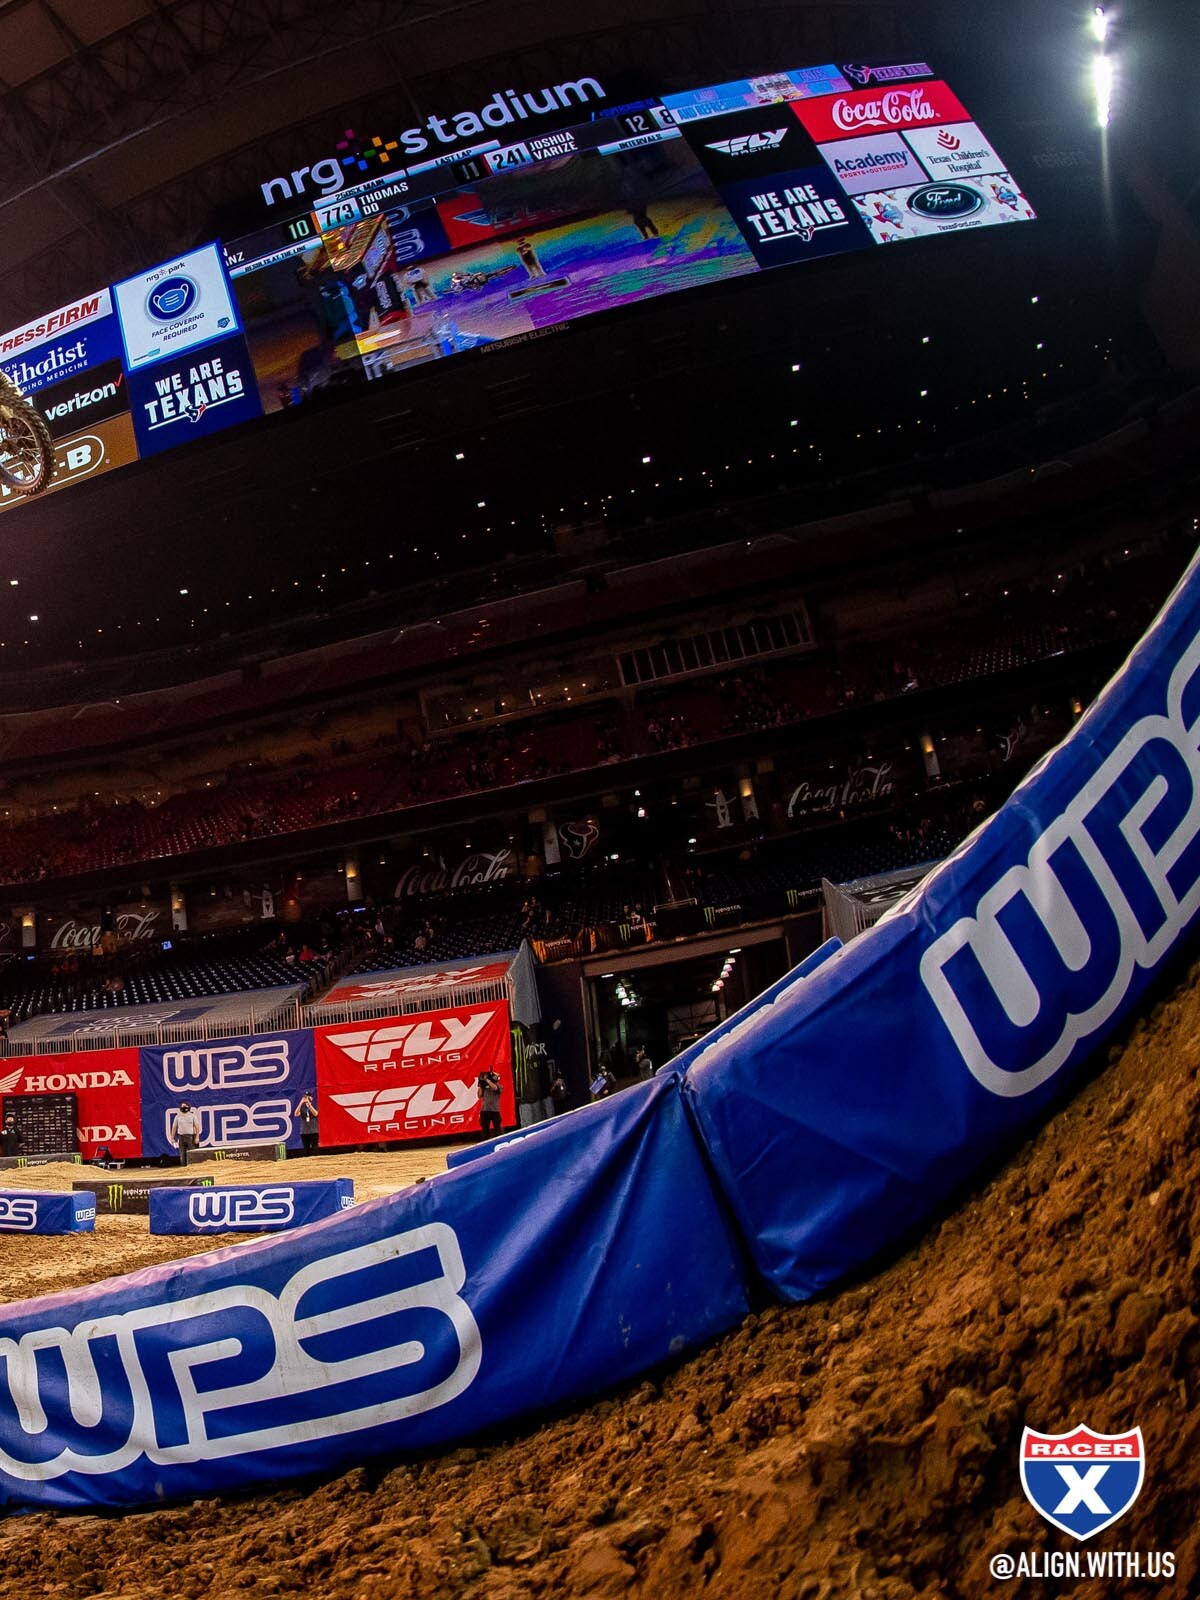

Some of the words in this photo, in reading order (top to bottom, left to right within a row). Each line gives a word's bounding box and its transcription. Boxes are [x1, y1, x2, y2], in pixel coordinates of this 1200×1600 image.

[832, 88, 935, 131] Coca-Cola
[625, 115, 649, 133] 12
[260, 158, 345, 206] nrg
[400, 77, 607, 154] stadium
[529, 131, 574, 152] JOSHUA
[533, 141, 578, 161] VARIZE
[618, 133, 663, 149] INTERVALS
[704, 128, 788, 154] FLY
[731, 143, 781, 157] RACING
[435, 154, 458, 168] LAST
[458, 149, 473, 161] LAP
[493, 144, 528, 170] 241
[834, 150, 908, 173] Academy
[927, 154, 951, 165] Texas
[951, 149, 990, 162] Children's
[948, 161, 982, 174] Hospital
[458, 160, 481, 180] 11
[359, 182, 409, 206] THOMAS
[363, 179, 386, 191] MAIN
[363, 202, 380, 215] DO
[750, 190, 783, 212] WE
[785, 184, 819, 205] ARE
[926, 190, 962, 211] Ford
[322, 203, 355, 227] 773
[747, 199, 846, 236] TEXANS
[288, 219, 311, 240] 10
[146, 273, 160, 283] nrg
[168, 261, 186, 275] park
[151, 326, 169, 338] FACE
[169, 312, 205, 331] COVERING
[163, 324, 198, 341] REQUIRED
[480, 334, 529, 354] MITSUBISHI
[529, 322, 570, 340] ELECTRIC
[46, 360, 89, 382] MEDICINE
[154, 372, 183, 397] WE
[189, 358, 222, 383] ARE
[44, 382, 117, 421] verizon
[144, 369, 244, 424] TEXANS
[325, 1010, 497, 1065] FLY
[162, 1039, 290, 1093] WPS
[363, 1052, 462, 1073] RACING
[24, 1069, 135, 1093] HONDA
[328, 1076, 480, 1124] FLY
[77, 1123, 137, 1144] NDA
[367, 1113, 467, 1134] RACING
[122, 1188, 151, 1196] MONSTE
[188, 1187, 295, 1228] WPS
